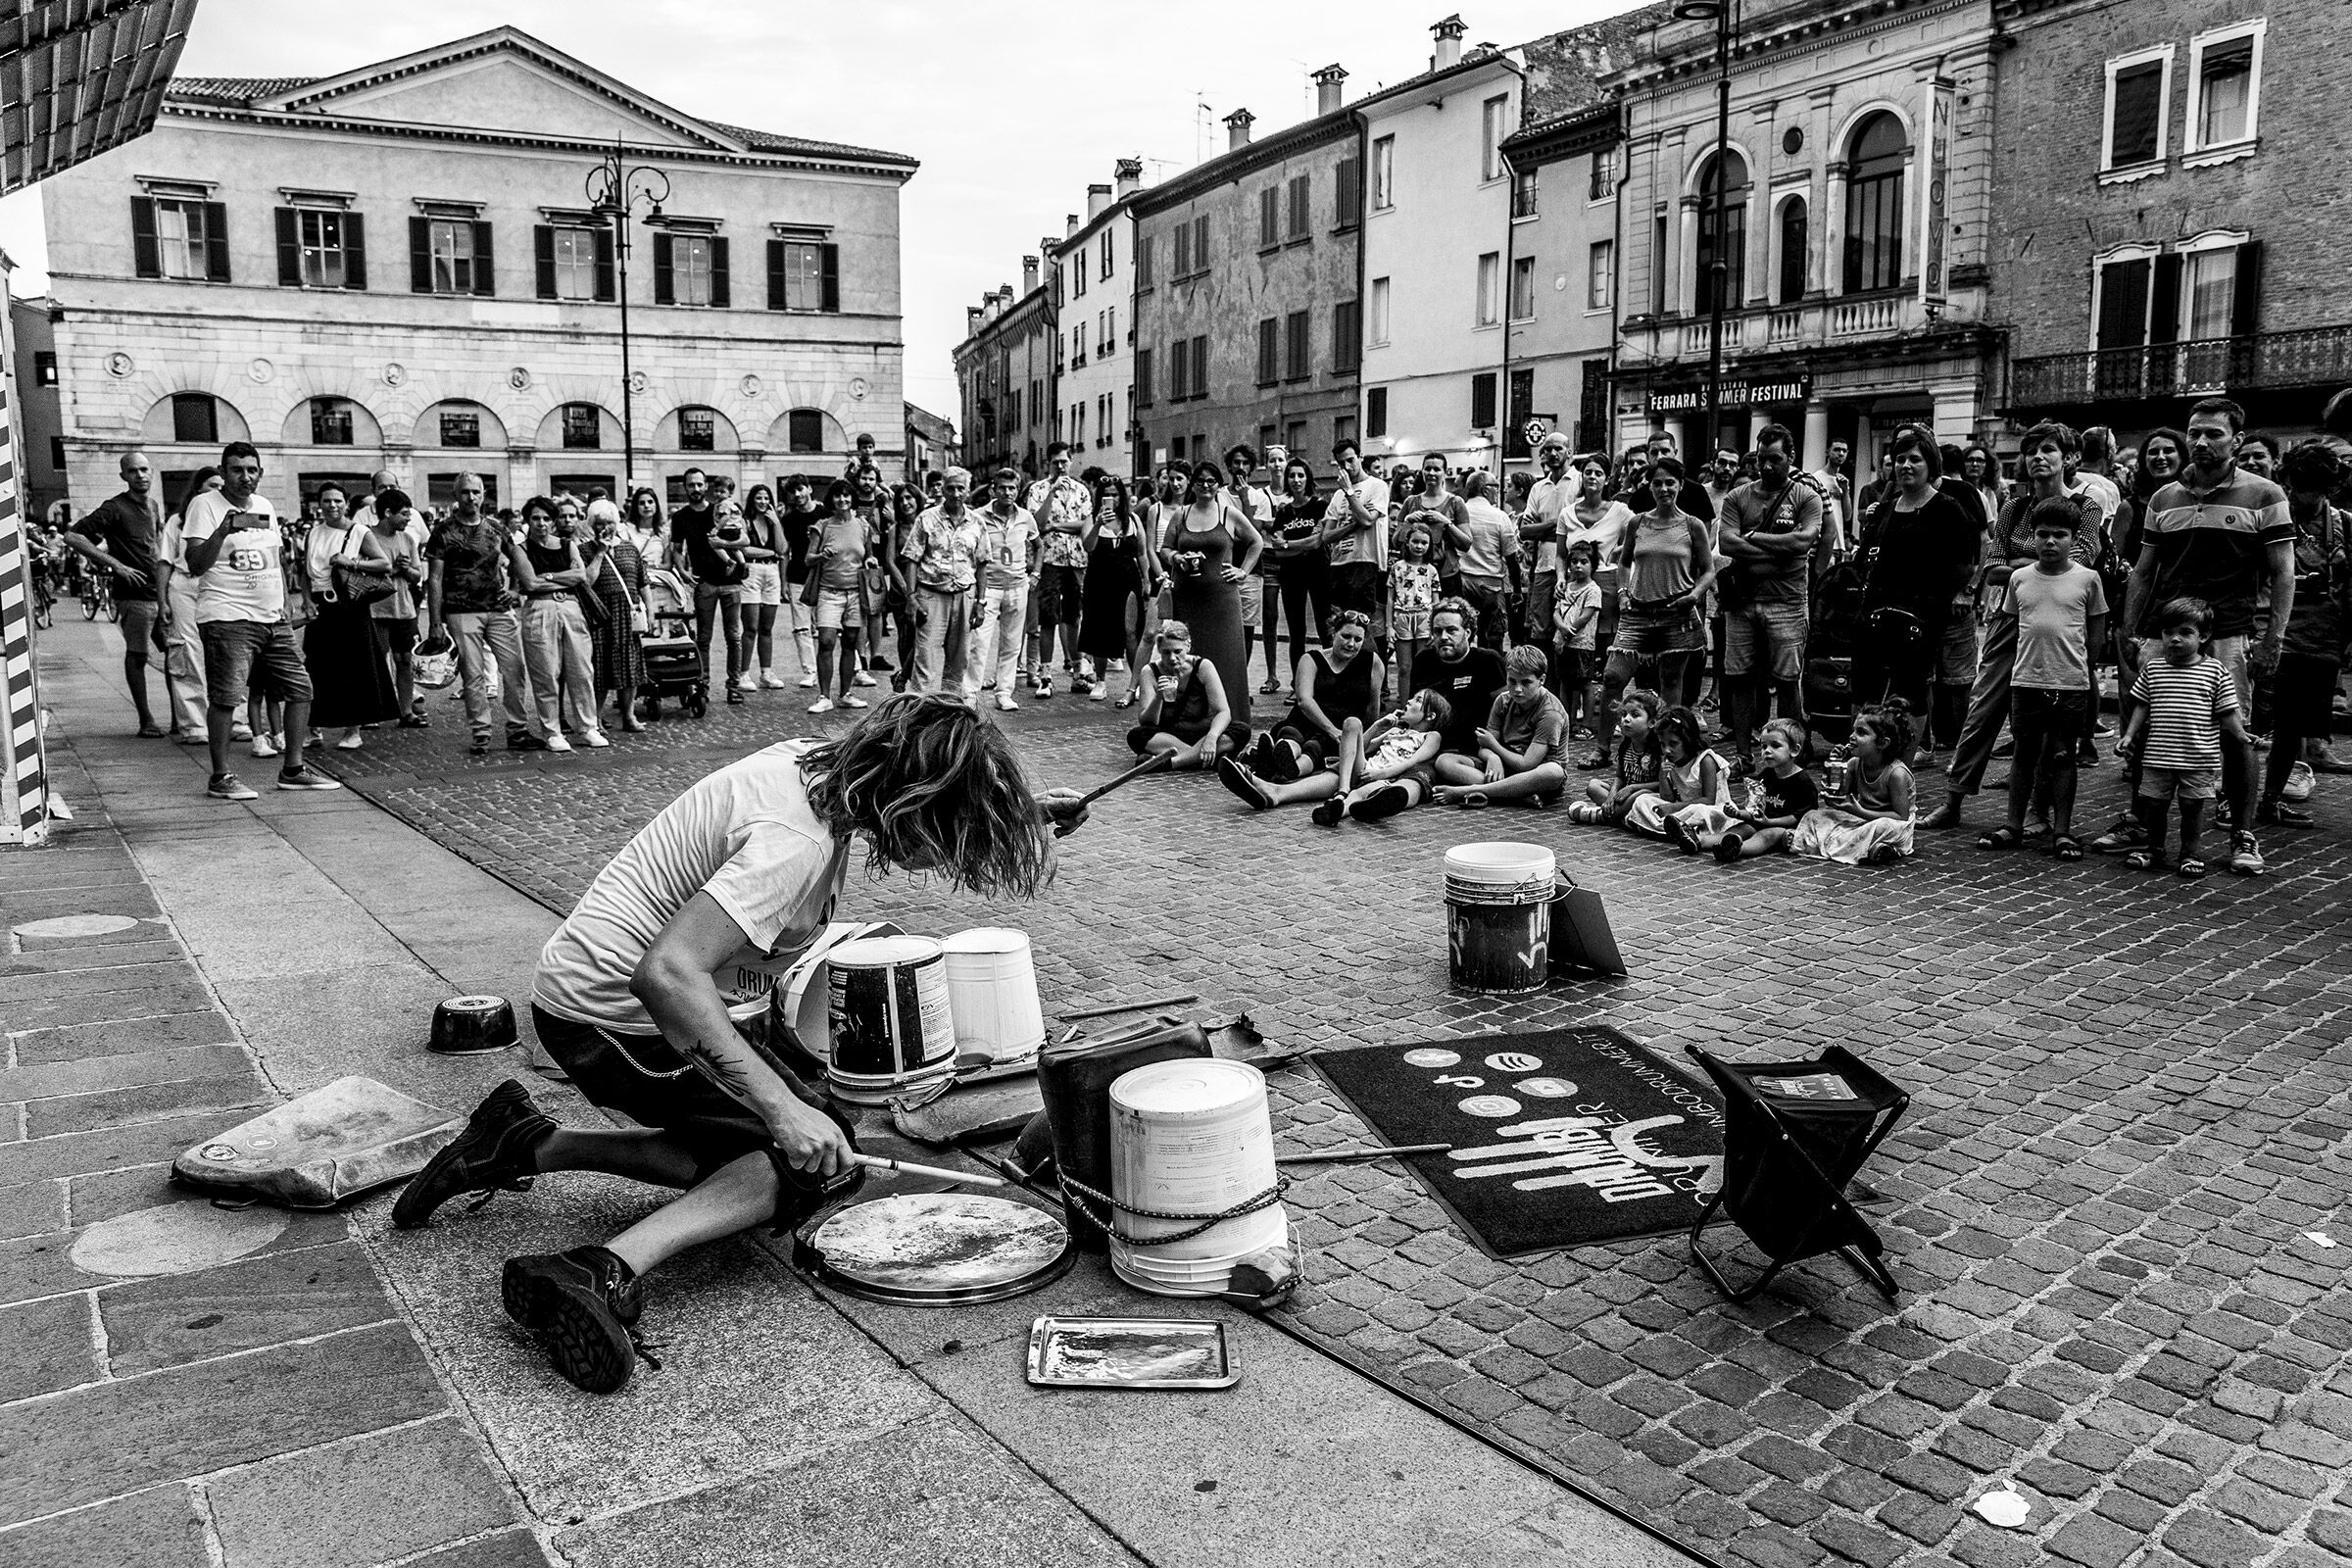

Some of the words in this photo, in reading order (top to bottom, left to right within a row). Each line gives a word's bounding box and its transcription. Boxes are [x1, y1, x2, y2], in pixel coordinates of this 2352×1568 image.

[1926, 99, 1948, 287] NUOVO
[1650, 393, 1696, 411] FERRARA
[1700, 388, 1746, 407] SMMER
[1750, 383, 1802, 403] FESTIVAL
